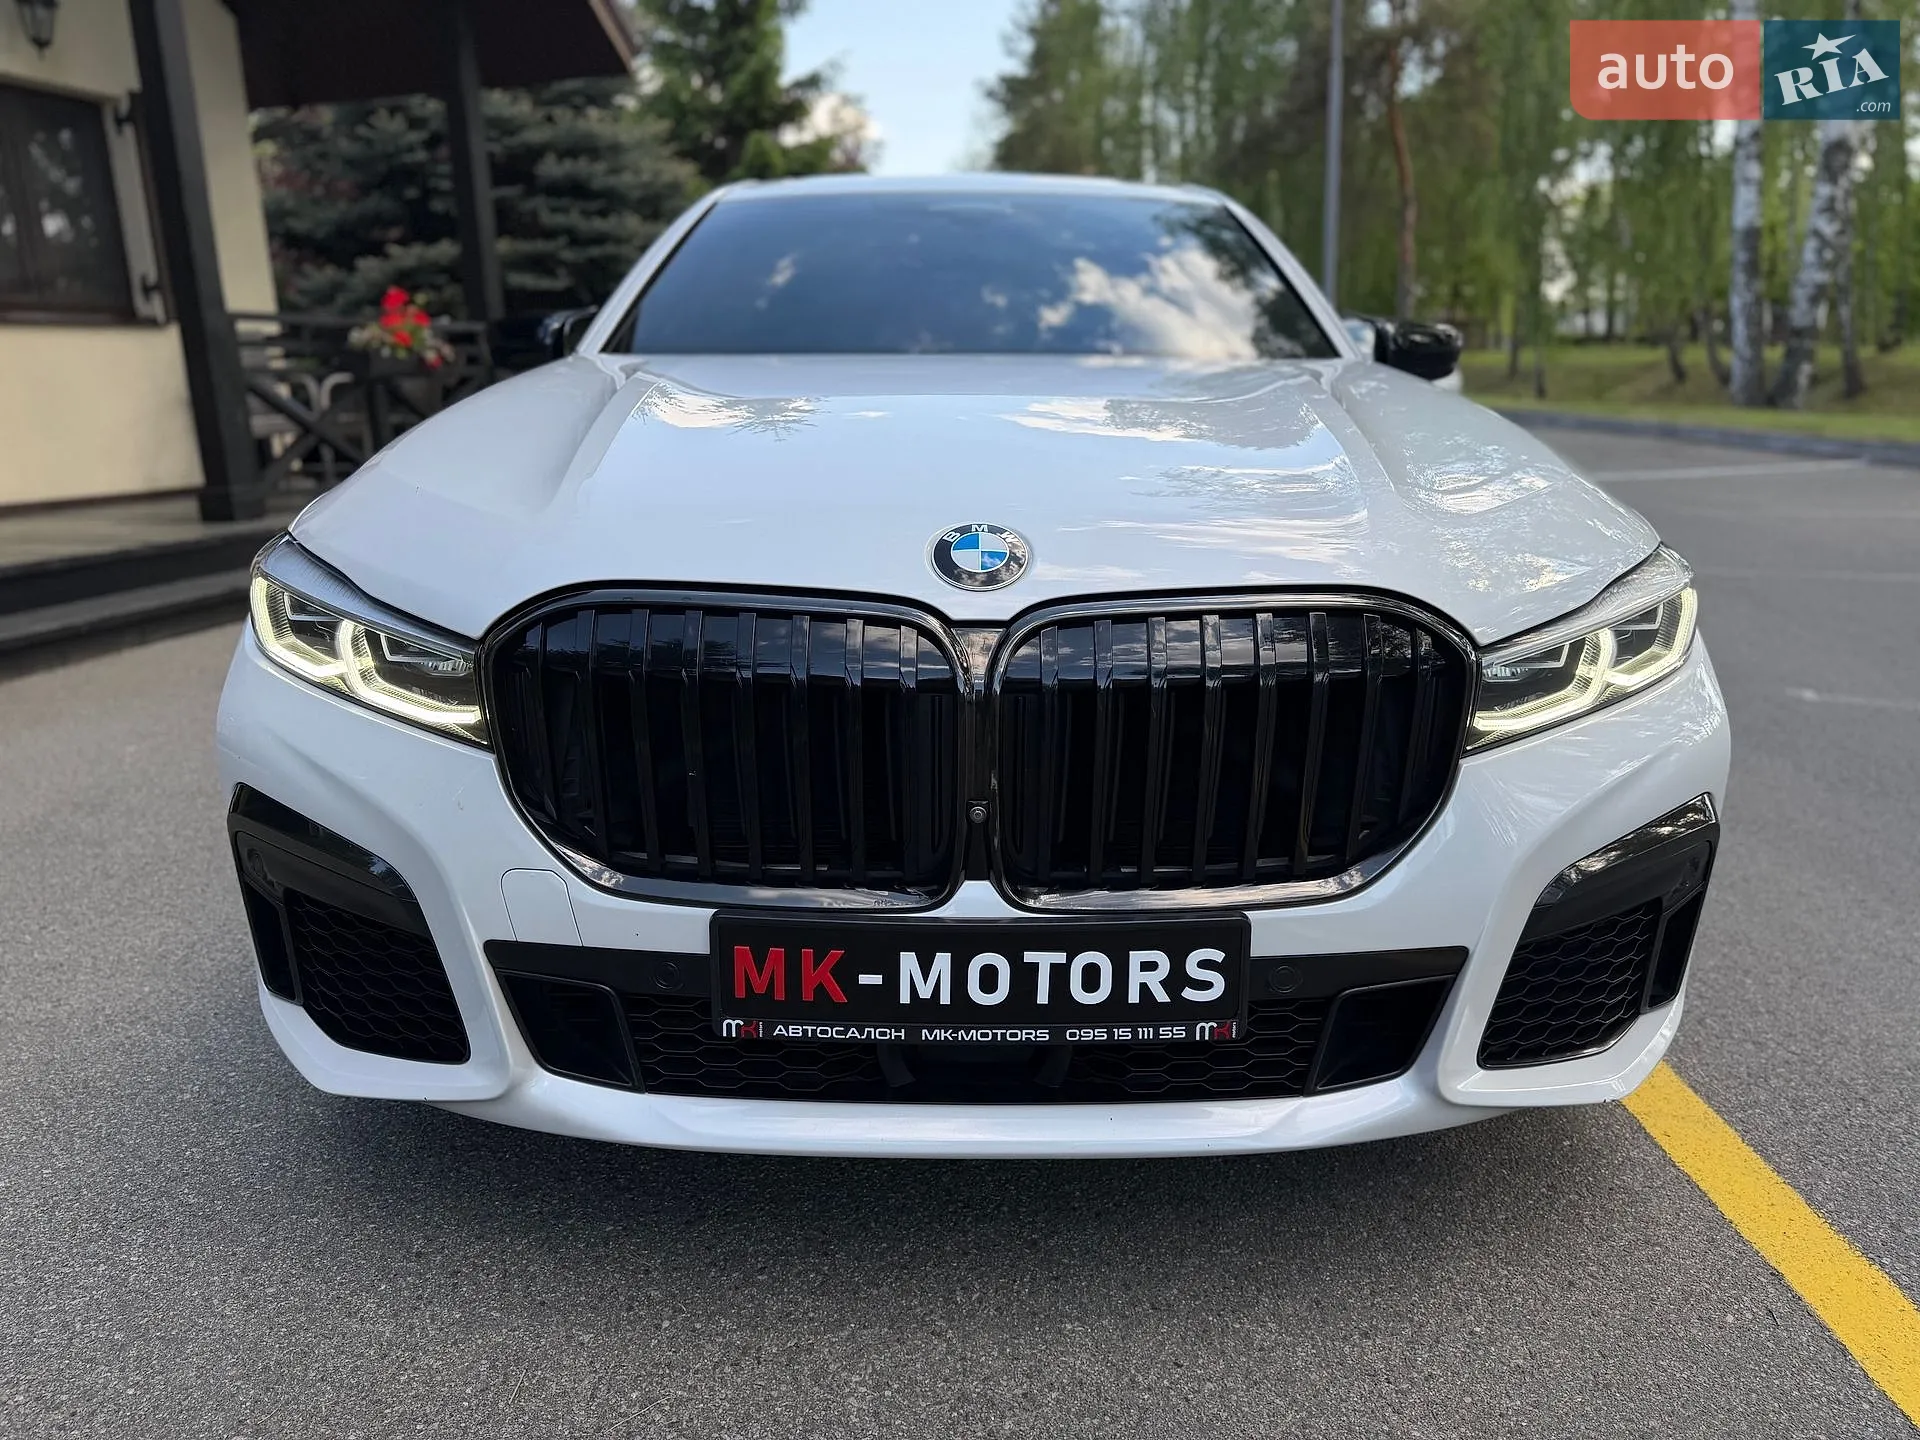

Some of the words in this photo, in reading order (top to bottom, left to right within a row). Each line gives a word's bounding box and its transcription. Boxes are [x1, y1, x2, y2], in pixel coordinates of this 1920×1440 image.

[942, 524, 1021, 544] BMW
[733, 945, 1226, 1005] MK-MOTORS
[773, 1024, 905, 1040] АВТОСАЛОН
[921, 1028, 1050, 1041] MK-MOTORS
[1066, 1028, 1107, 1041] 095
[1113, 1027, 1132, 1040] 15
[1137, 1027, 1153, 1040] 111
[1159, 1026, 1186, 1039] 55
